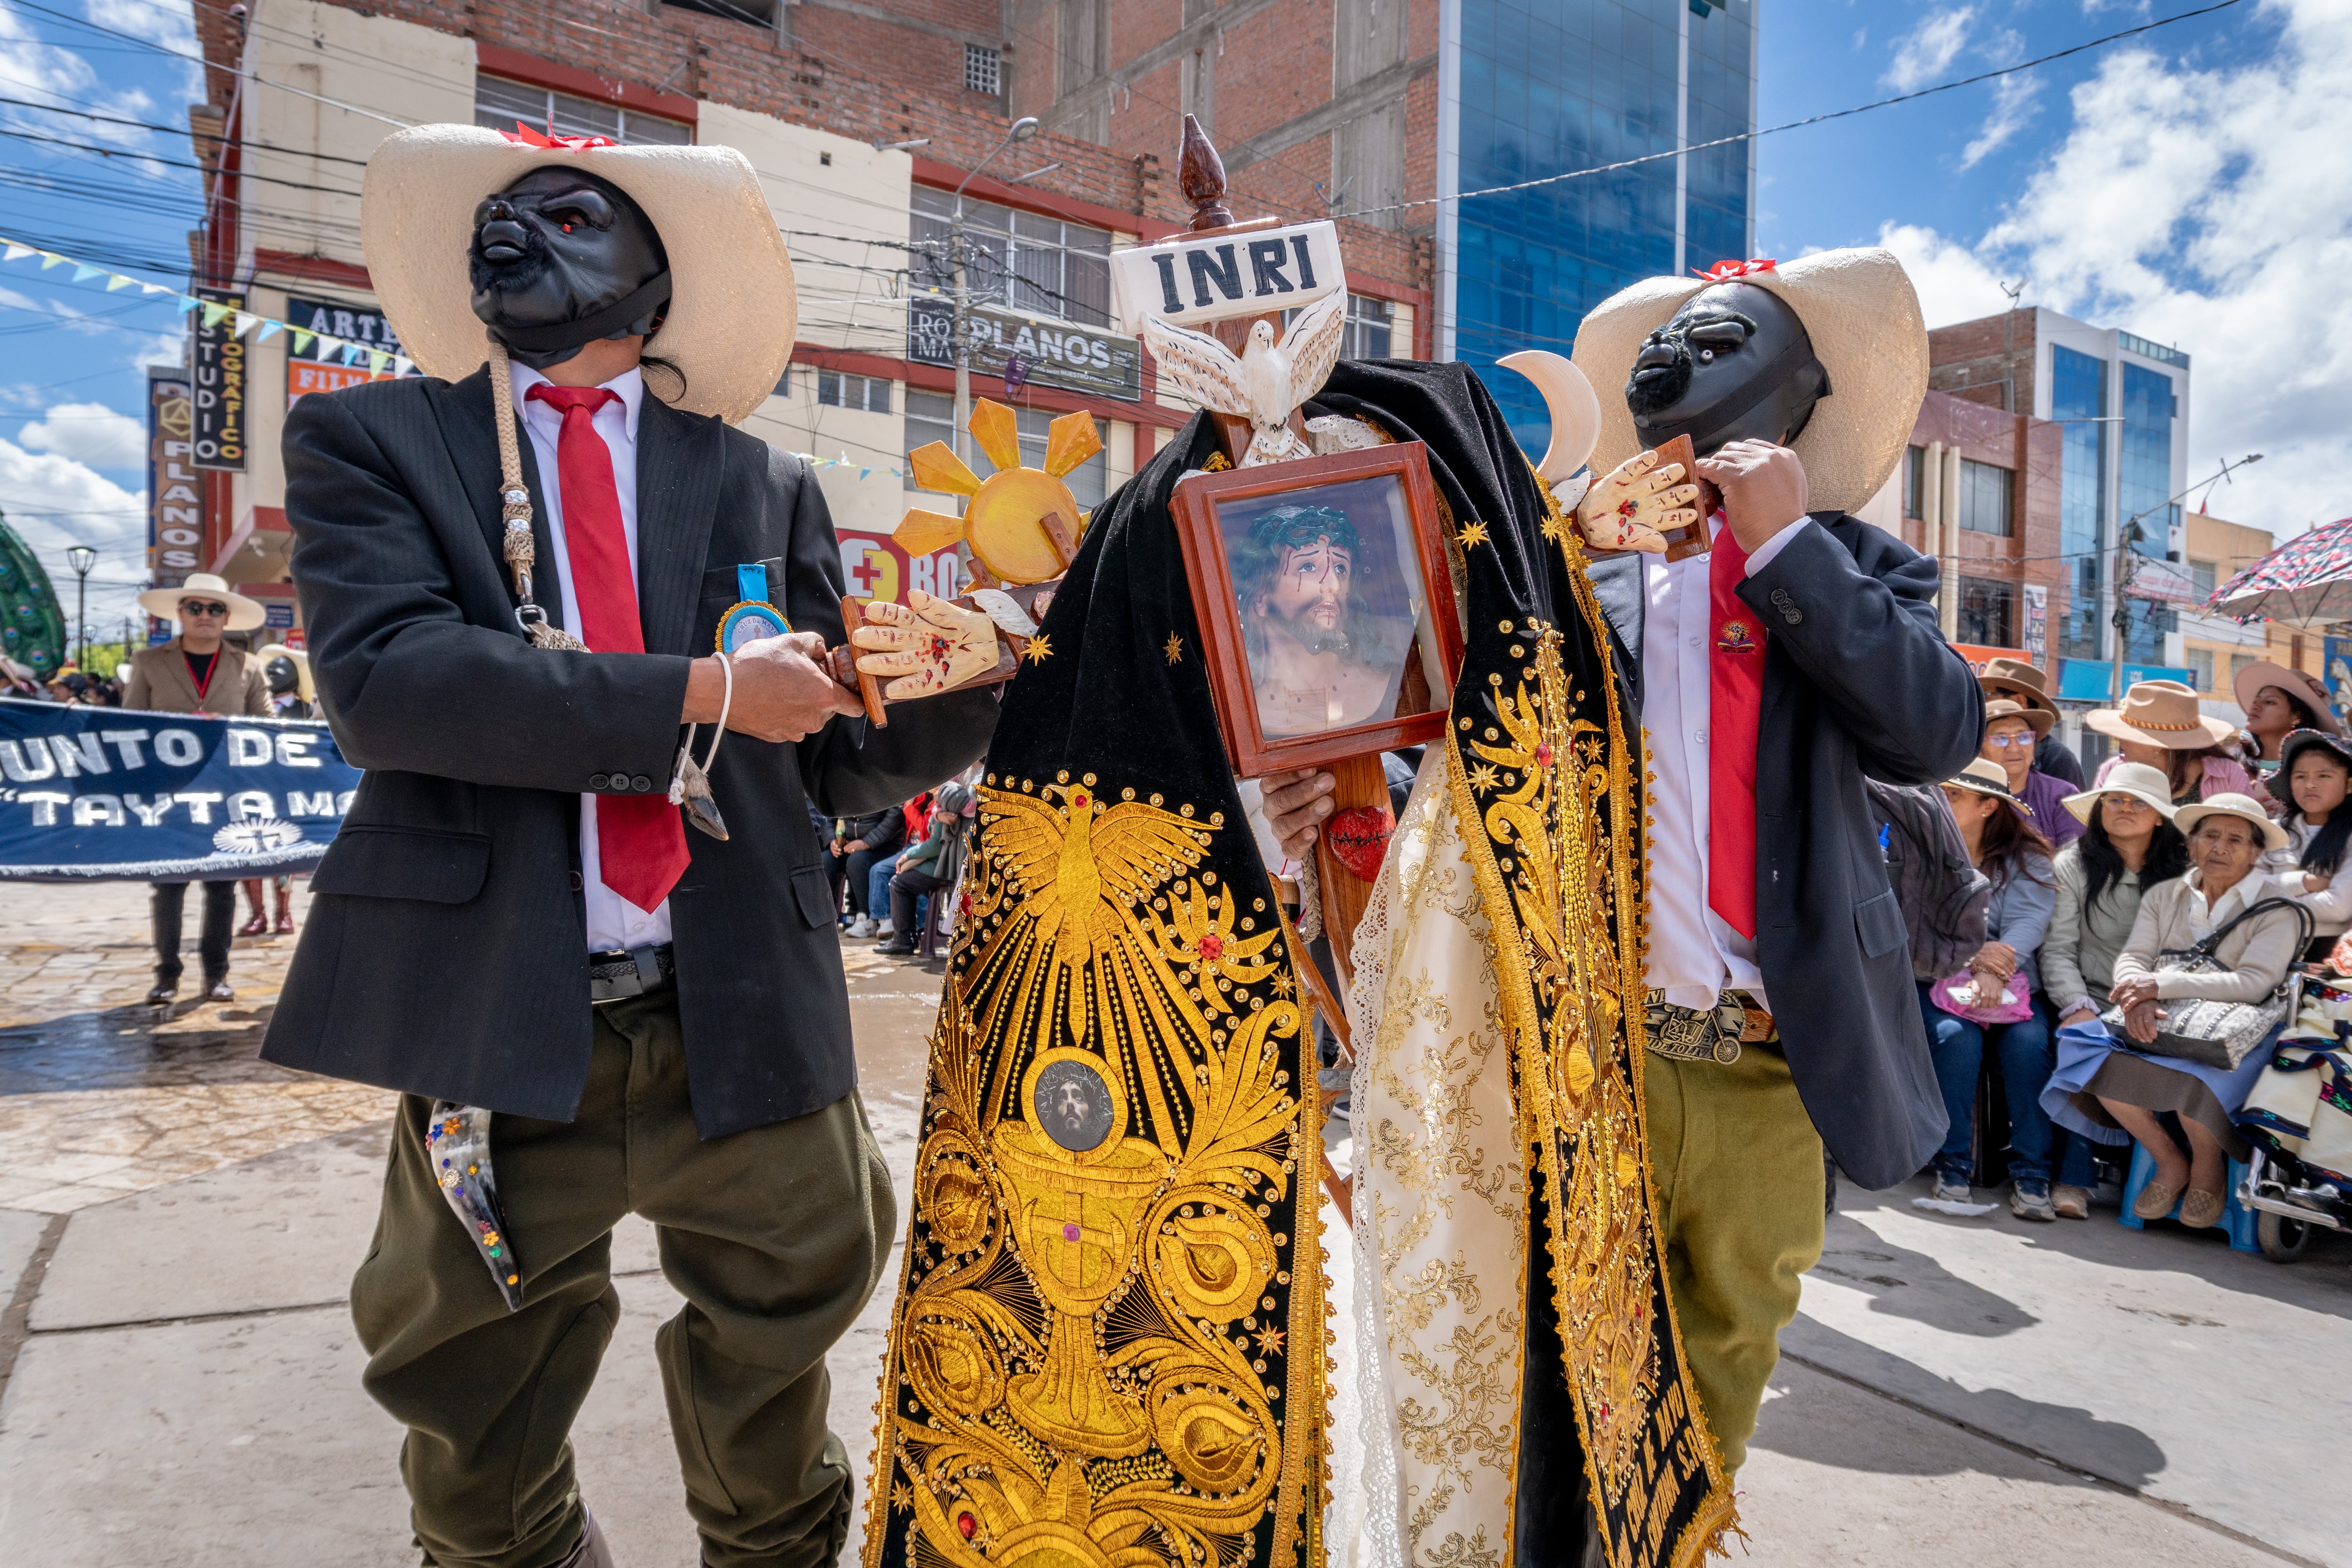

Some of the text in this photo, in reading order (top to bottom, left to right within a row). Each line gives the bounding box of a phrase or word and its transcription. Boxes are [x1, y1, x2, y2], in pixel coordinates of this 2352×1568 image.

[1151, 234, 1317, 314] INRI
[918, 313, 951, 338] RO
[969, 316, 1110, 369] PLANOS
[196, 294, 219, 460] ESTUDIO
[1060, 369, 1089, 380] NUESTRO
[161, 439, 199, 568] PLANOS
[737, 618, 752, 635] CRUZ
[762, 618, 779, 637] MAYO
[0, 729, 323, 783] UNTO DE
[1669, 1043, 1685, 1053] TO
[1684, 1045, 1712, 1059] LIVE
